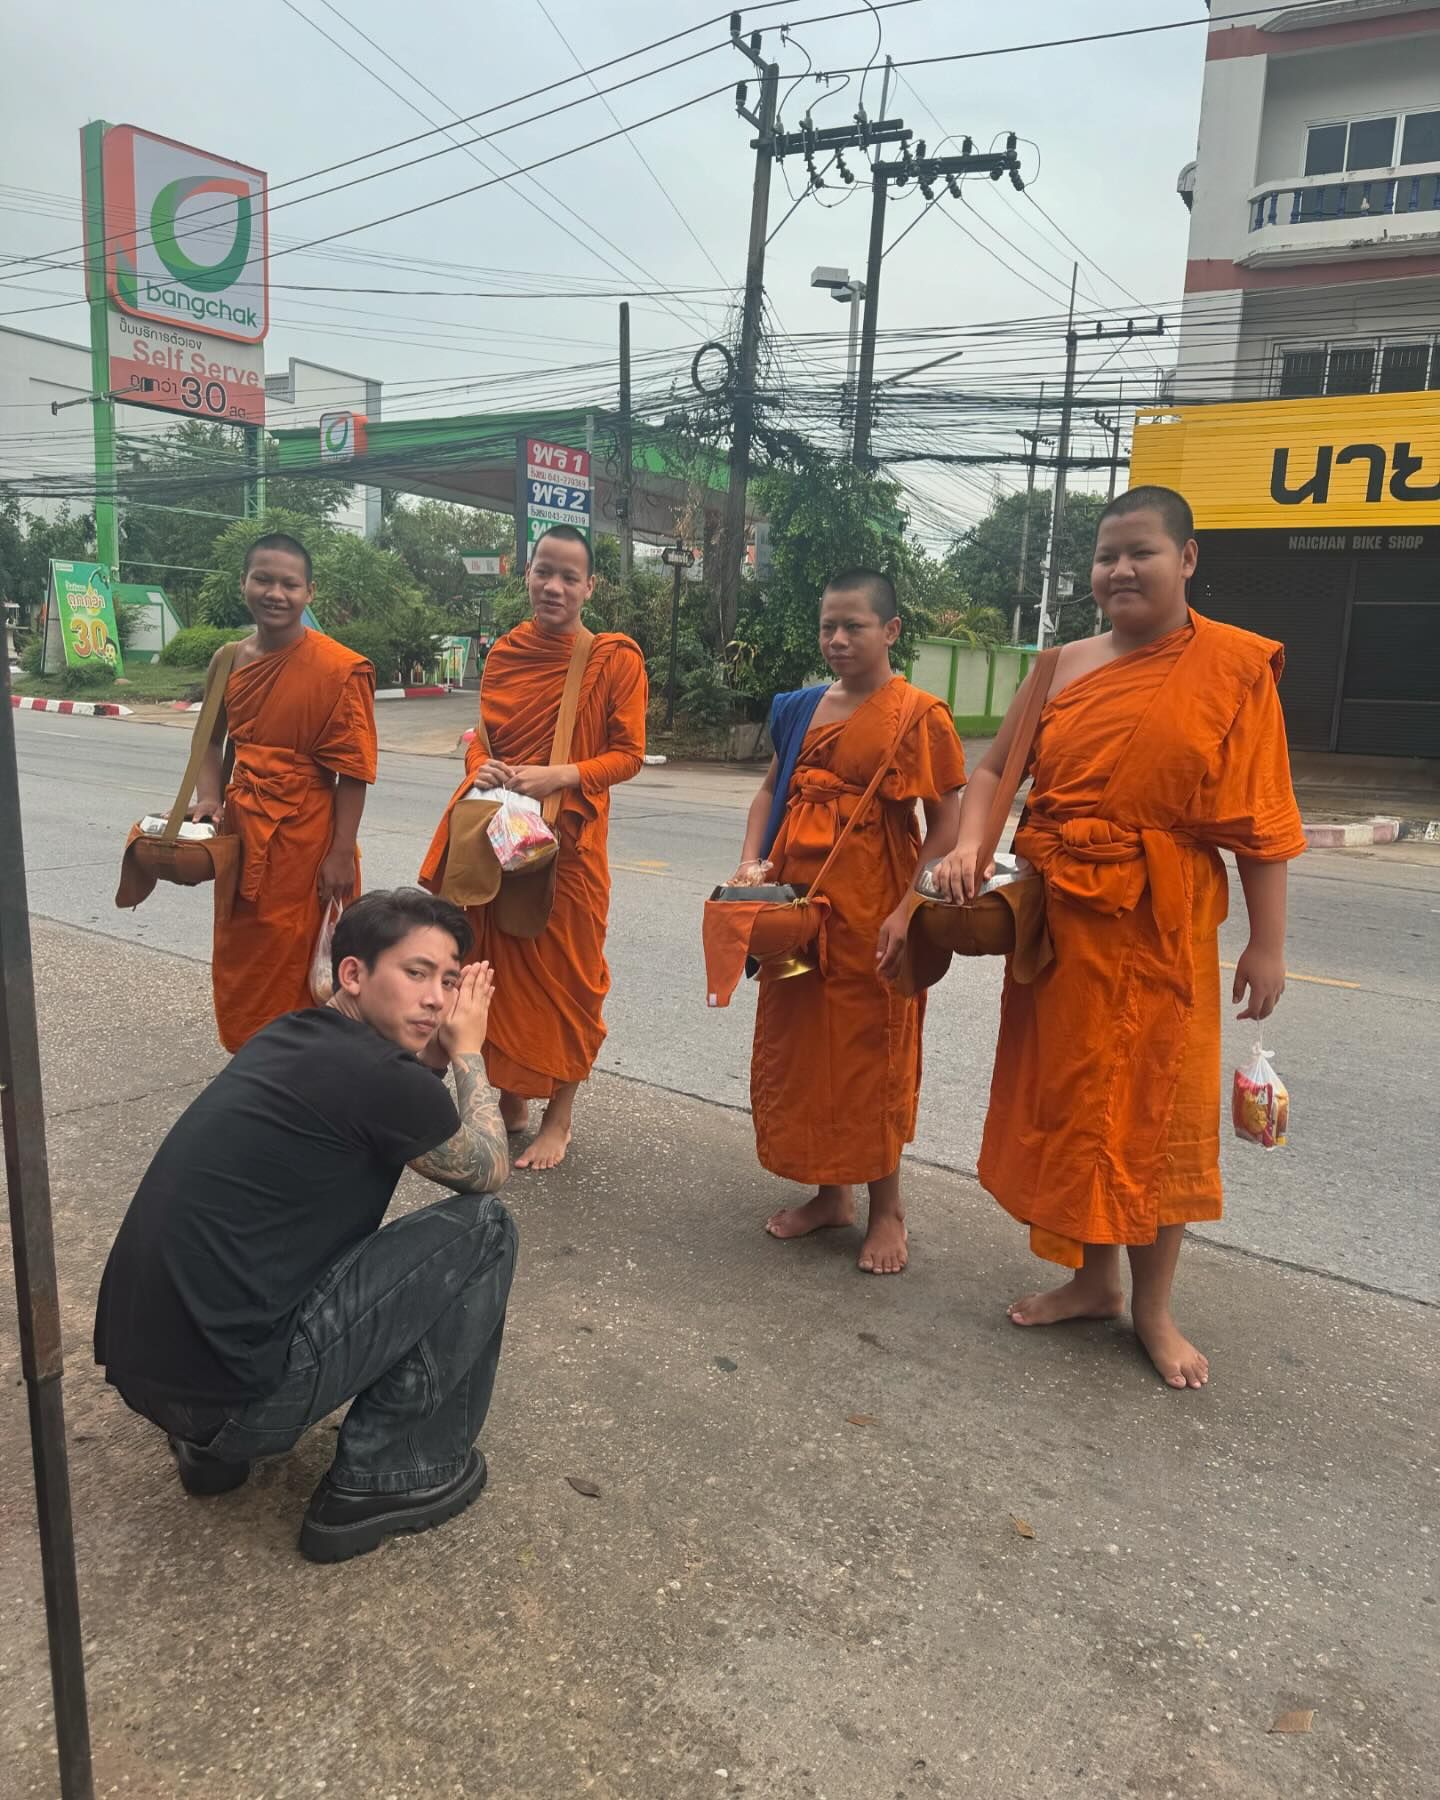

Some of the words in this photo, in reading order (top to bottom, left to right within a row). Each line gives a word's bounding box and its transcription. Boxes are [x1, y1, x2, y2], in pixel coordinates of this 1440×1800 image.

[146, 280, 258, 329] bangchak
[133, 338, 184, 372] Self
[190, 352, 260, 387] Serve
[181, 376, 227, 414] 30
[532, 443, 568, 470] พร
[573, 455, 583, 473] 1
[532, 482, 568, 507] พร
[570, 491, 586, 511] 2
[1288, 535, 1346, 551] NAICHAN
[1352, 535, 1383, 550] BIKE
[1388, 535, 1424, 550] SHOP
[70, 618, 108, 658] 30
